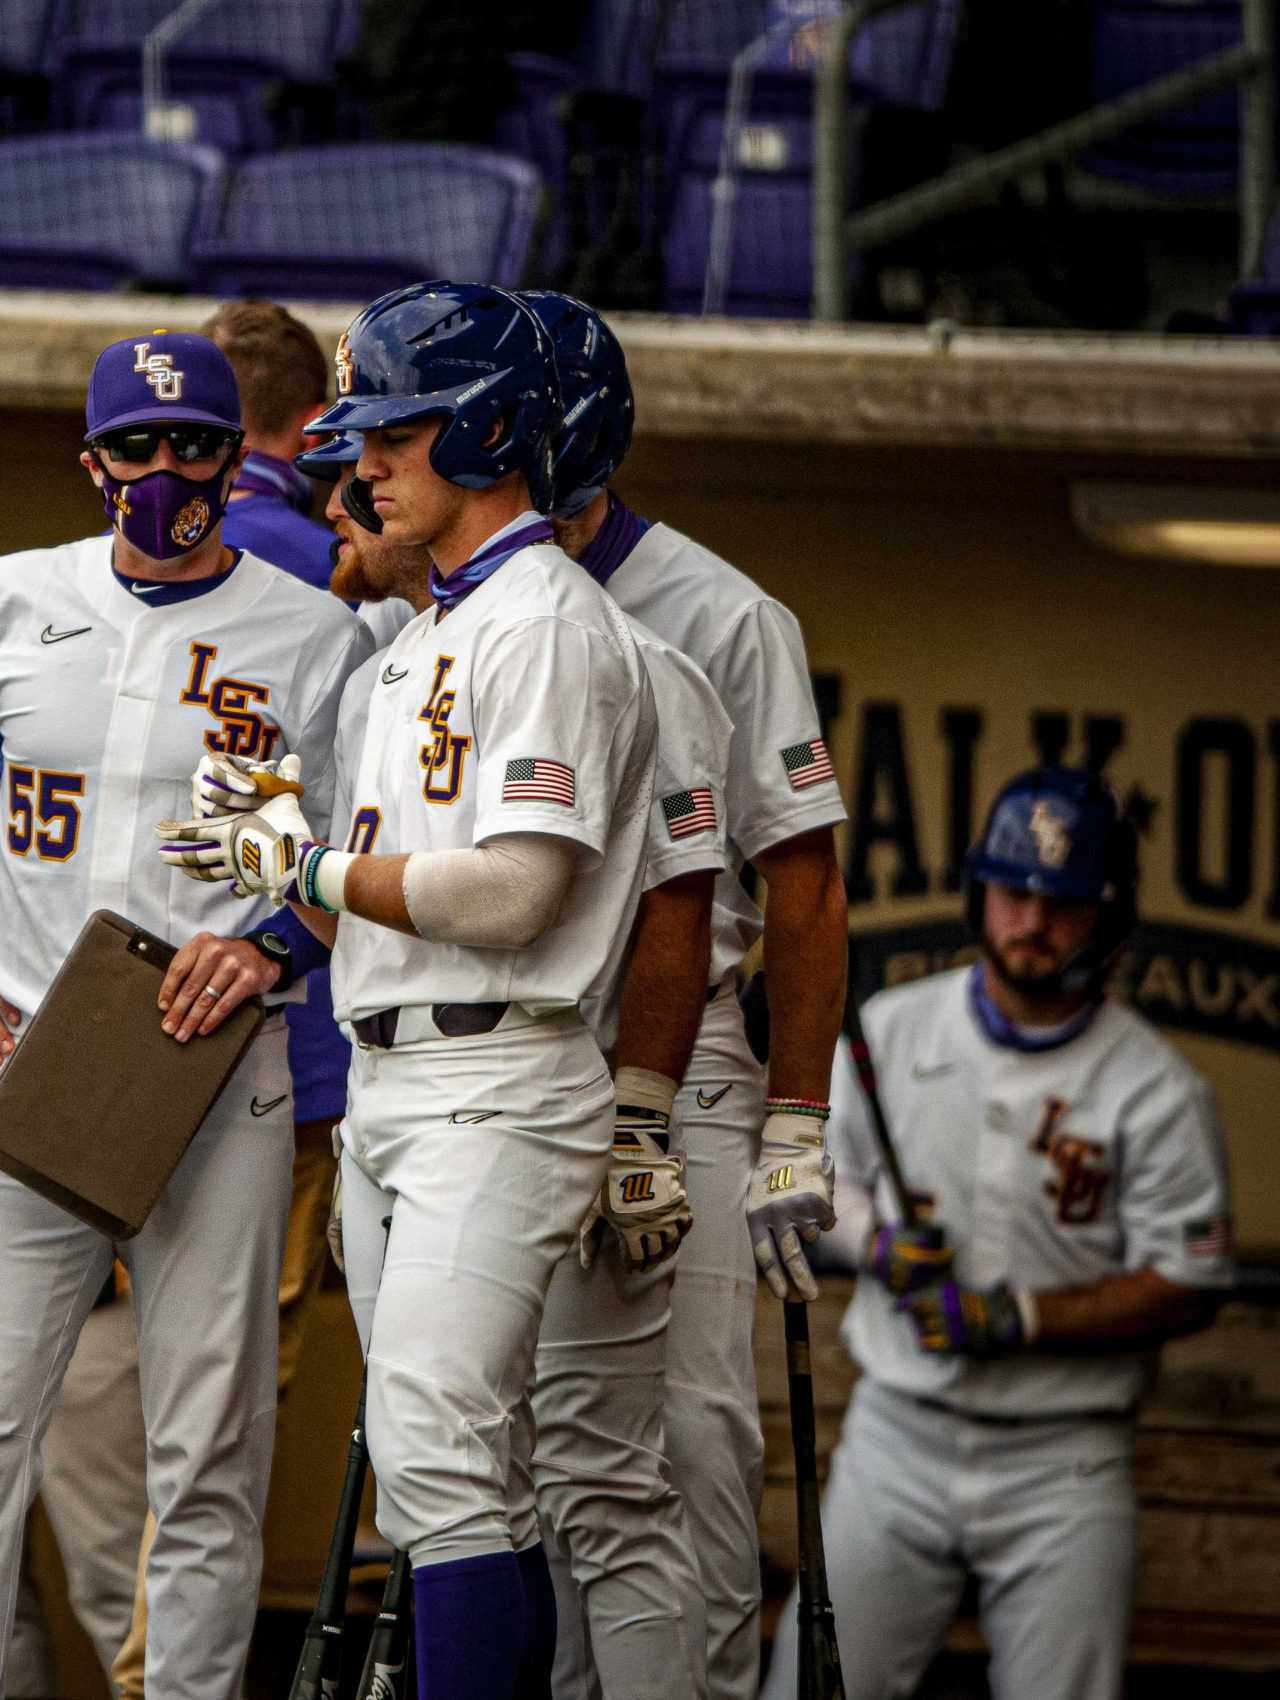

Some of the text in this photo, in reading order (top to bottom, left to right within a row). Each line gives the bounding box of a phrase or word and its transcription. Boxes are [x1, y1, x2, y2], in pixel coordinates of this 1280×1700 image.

[133, 342, 184, 400] LSU
[456, 378, 487, 405] marucci
[417, 654, 472, 805] LSU
[7, 762, 86, 863] 55
[1028, 1094, 1112, 1228] LSU
